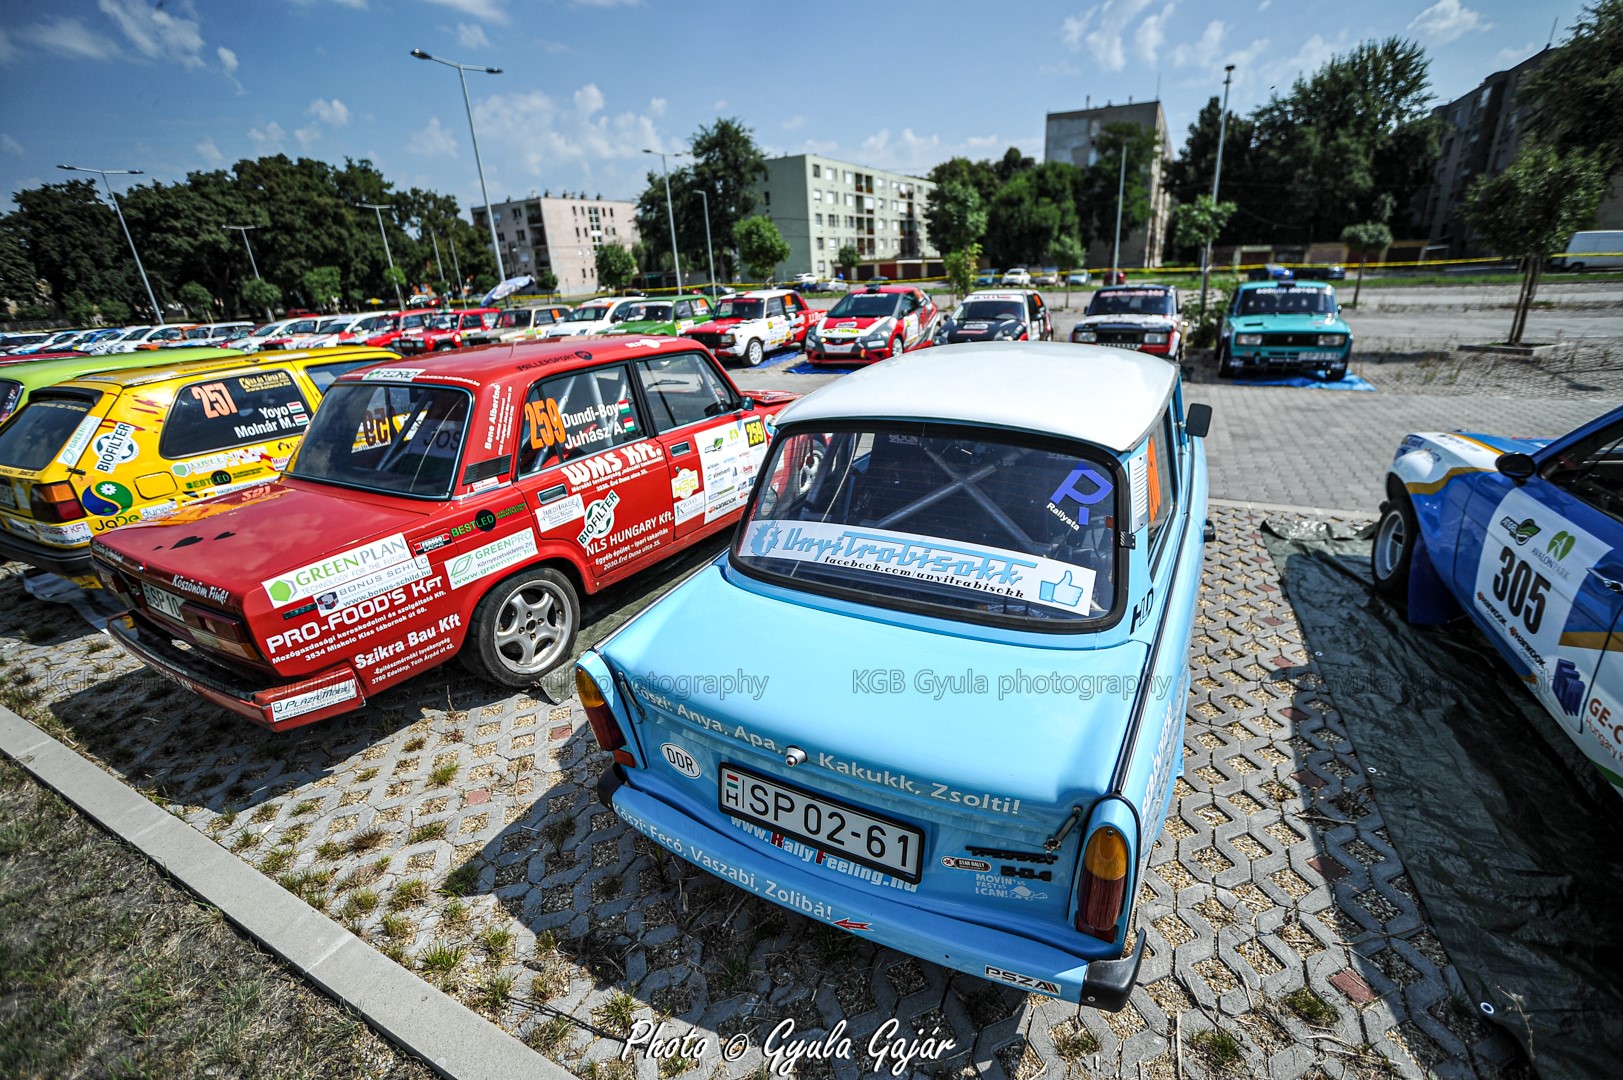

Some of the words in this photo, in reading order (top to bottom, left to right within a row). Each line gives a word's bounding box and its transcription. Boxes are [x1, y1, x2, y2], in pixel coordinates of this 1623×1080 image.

[516, 354, 576, 372] MILLERSPORT
[191, 382, 238, 419] 257
[259, 406, 289, 420] Yoyo
[561, 403, 620, 428] Dundi-Boy
[234, 419, 277, 438] Molnár
[280, 418, 296, 430] M.
[524, 398, 566, 450] 259
[564, 424, 612, 450] Juhász
[746, 422, 764, 445] 259
[97, 423, 130, 472] BIOFILTER
[560, 452, 622, 486] WMS
[620, 442, 662, 466] Kft.
[450, 514, 495, 538] BESTLED
[578, 492, 618, 544] BIOFILTER
[586, 538, 608, 557] NLS
[610, 516, 658, 546] HUNGARY
[659, 511, 674, 526] Kft.
[1046, 502, 1080, 532] Rallysta
[296, 538, 406, 586] GREENPLAN
[475, 530, 532, 560] GREENPRO
[595, 553, 612, 566] Egyéb
[613, 546, 631, 558] épület
[634, 538, 646, 549] ipari
[628, 549, 642, 559] Duna
[642, 544, 653, 554] utca
[302, 573, 349, 595] TECHNOLOGY
[352, 567, 366, 577] FOR
[368, 562, 380, 572] THE
[384, 553, 408, 568] FUTURE
[453, 547, 535, 586] www.greenpro.hu
[824, 555, 1024, 598] facebook.com/unyitrabisokk
[172, 574, 208, 598] Köszönöm
[208, 586, 229, 605] Fiúk!
[340, 575, 382, 596] BONUS
[343, 569, 432, 606] www.bonus-schild.hu
[1493, 546, 1552, 634] 305
[266, 588, 406, 654] PRO-FOOD'S
[272, 636, 336, 664] Mezőgazdasági
[337, 616, 386, 640] kereskedelmi
[387, 610, 397, 621] és
[397, 598, 433, 617] szolgáltató
[434, 590, 446, 600] Kft.
[305, 650, 326, 662] 3534
[327, 637, 358, 652] Miskolc
[358, 628, 375, 640] Kiss
[376, 616, 407, 633] tábornok
[407, 612, 416, 621] út
[354, 640, 405, 669] Szikra
[407, 627, 437, 646] Bau
[438, 613, 462, 633] Kft
[418, 636, 450, 656] tevékenység
[387, 664, 410, 679] Edelény,
[411, 657, 424, 668] Tóth
[424, 650, 440, 662] Árpád
[440, 646, 446, 654] út
[630, 680, 672, 712] Köszi:
[678, 703, 728, 736] Anya,
[734, 725, 782, 754] Apa,
[819, 752, 921, 794] Kakukk,
[930, 782, 1020, 816] Zsolti!
[1585, 715, 1618, 758] Hungary
[666, 748, 695, 774] DDR
[726, 789, 739, 807] H
[750, 784, 795, 821] SP
[804, 804, 910, 868] 02-61
[612, 802, 649, 835] Köszi:
[650, 826, 687, 857] Fecó,
[690, 845, 759, 892] Vaszabi,
[765, 880, 832, 921] Zolibá!
[976, 873, 1016, 885] MOVIN'
[976, 881, 998, 889] FAST
[980, 888, 1008, 898] CAN!
[986, 966, 1052, 991] PSZA
